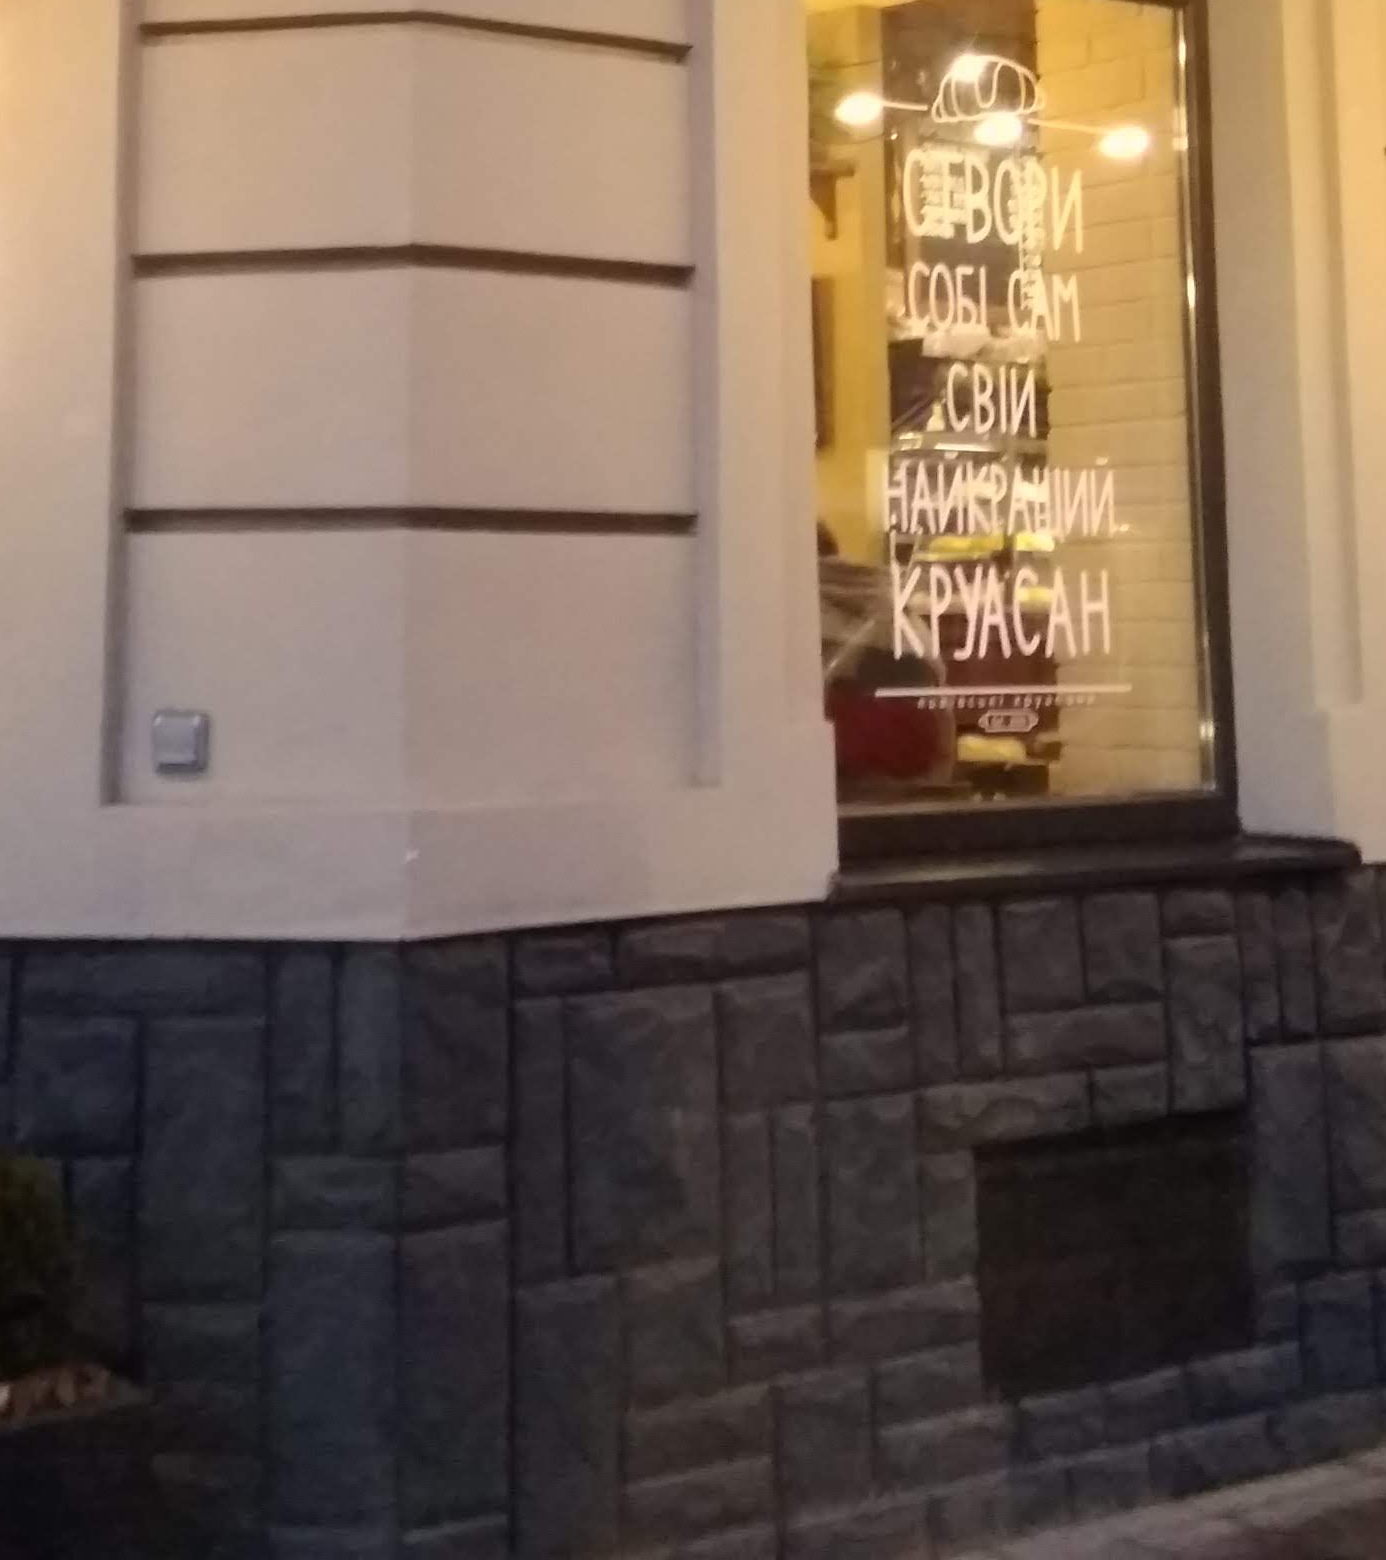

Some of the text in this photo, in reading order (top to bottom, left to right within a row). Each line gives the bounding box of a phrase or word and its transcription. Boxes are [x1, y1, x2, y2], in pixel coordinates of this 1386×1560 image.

[903, 148, 1084, 254] СТВОРИ
[907, 262, 1082, 344] СОБІ САМ
[946, 354, 1038, 439] СВІЙ
[884, 450, 1117, 544] НАЙКРАЩИЙ
[892, 562, 1111, 661] КРУАСАН
